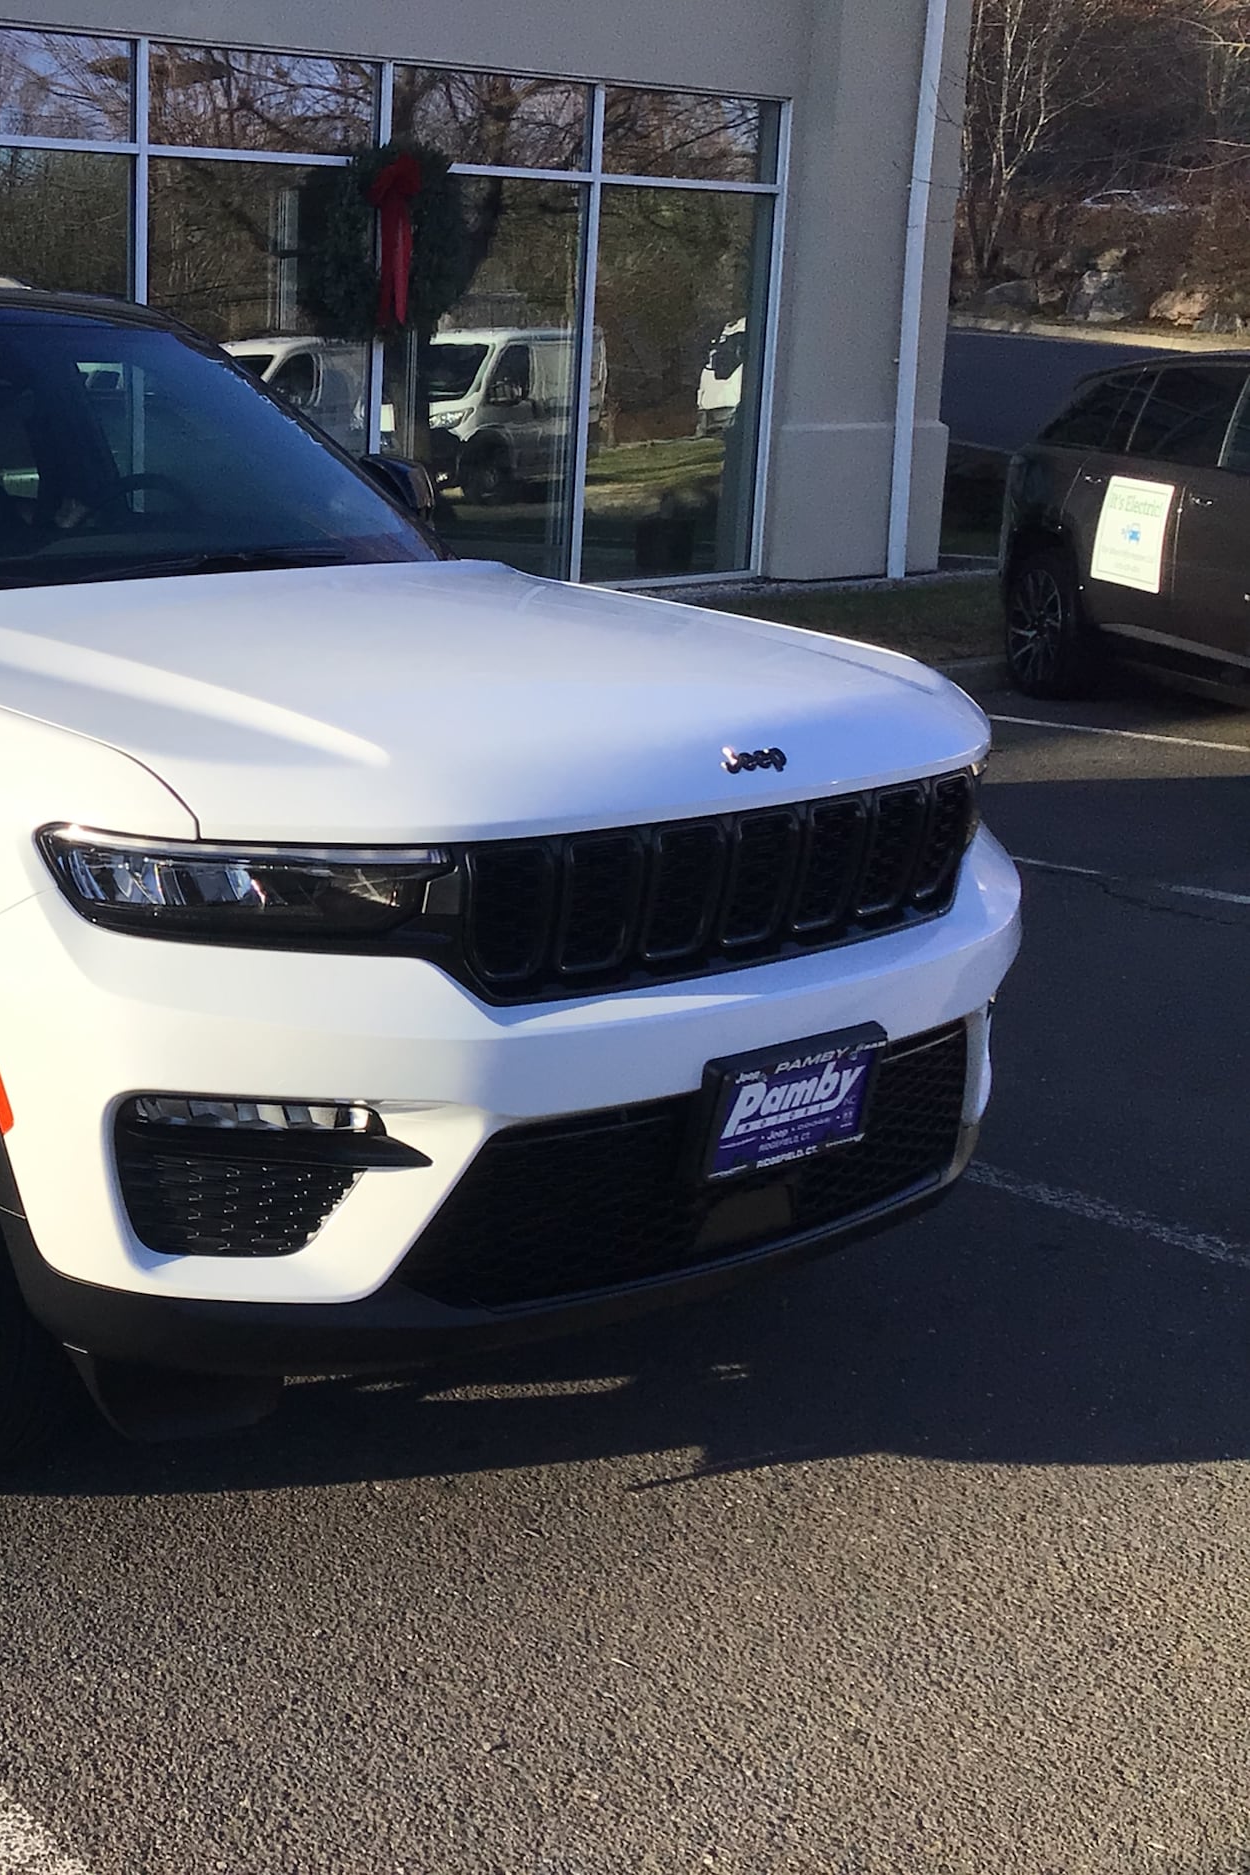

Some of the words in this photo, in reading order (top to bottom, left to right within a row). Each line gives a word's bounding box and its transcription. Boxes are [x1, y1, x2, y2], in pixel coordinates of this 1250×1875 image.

[721, 746, 787, 774] Jeep
[774, 1046, 850, 1074] PAMBY
[721, 1061, 866, 1140] Pamby
